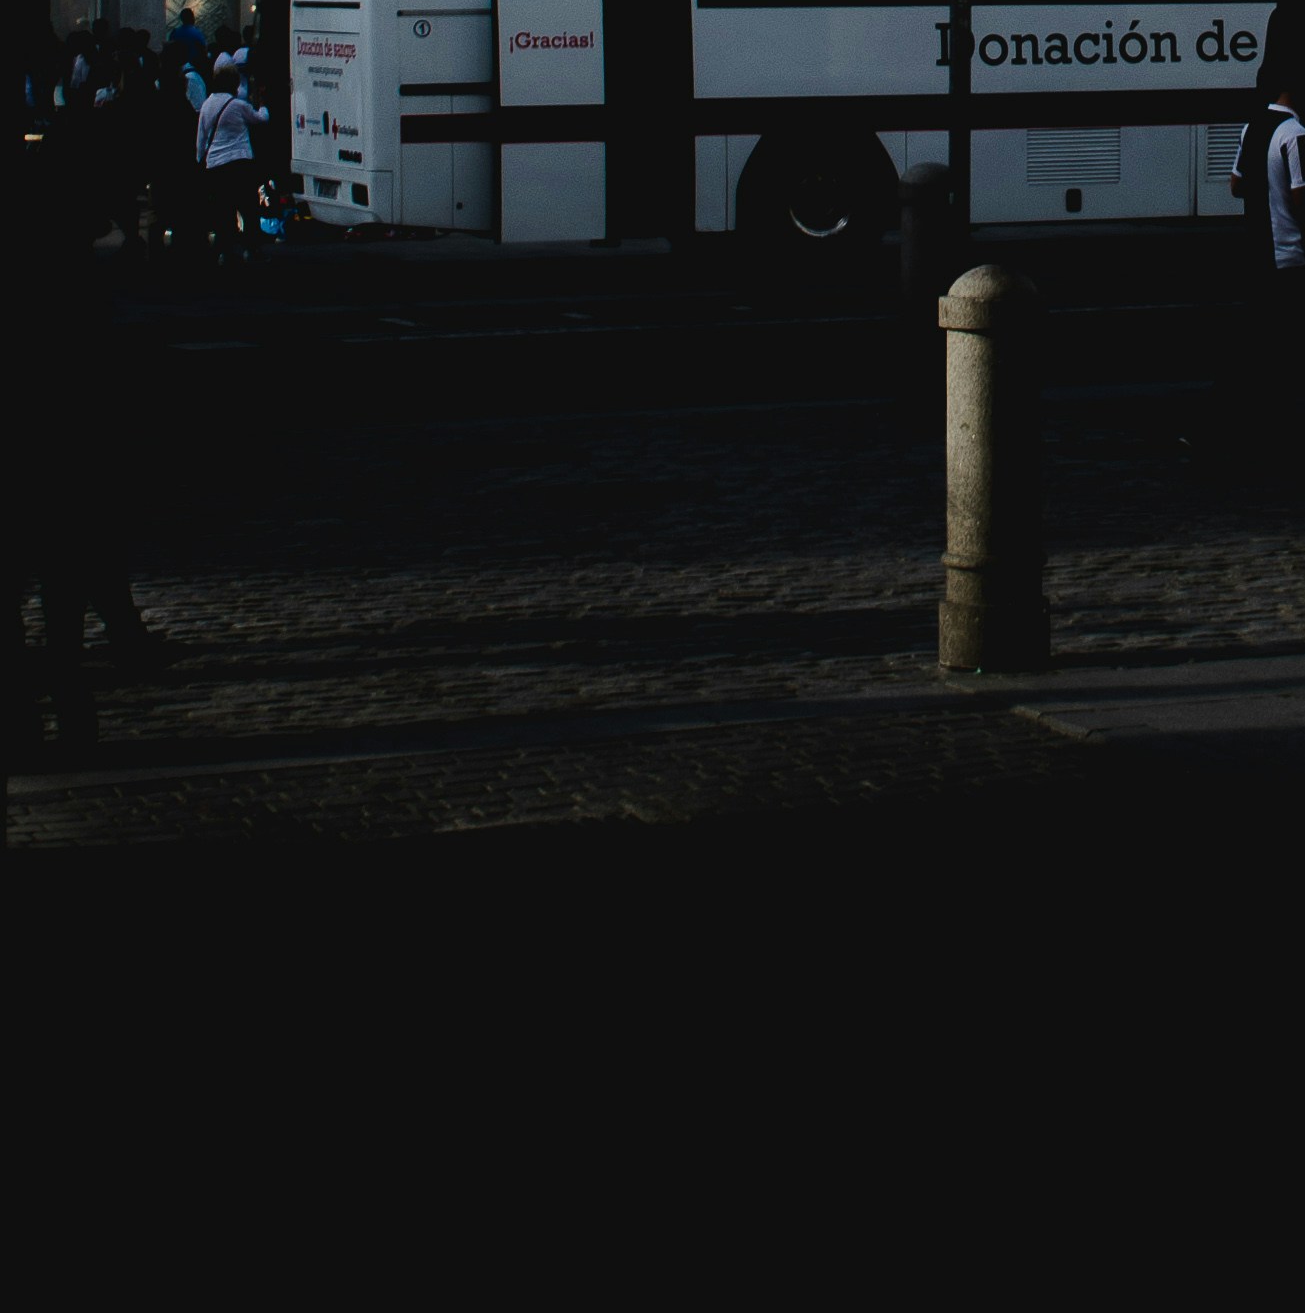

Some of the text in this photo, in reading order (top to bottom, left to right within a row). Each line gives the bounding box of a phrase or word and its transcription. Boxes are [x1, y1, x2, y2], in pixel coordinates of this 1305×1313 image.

[297, 36, 356, 63] Donación de sangre
[509, 31, 594, 54] ¡Gracias!
[1196, 19, 1258, 62] de
